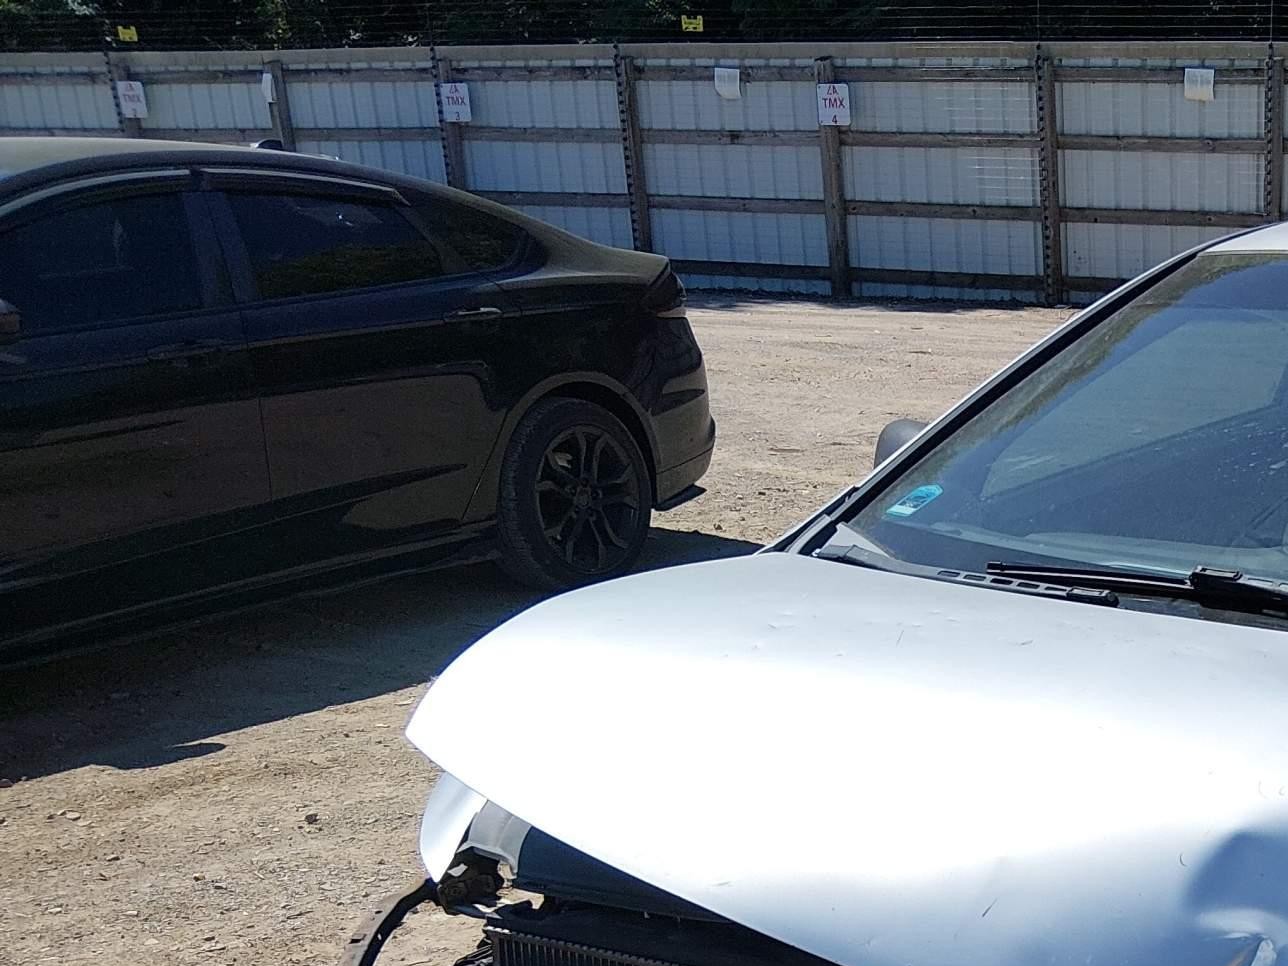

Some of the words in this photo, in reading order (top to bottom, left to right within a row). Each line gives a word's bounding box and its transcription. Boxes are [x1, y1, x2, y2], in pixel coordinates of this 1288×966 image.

[446, 96, 466, 106] TMX
[822, 97, 846, 109] TMX
[831, 114, 838, 124] 4
